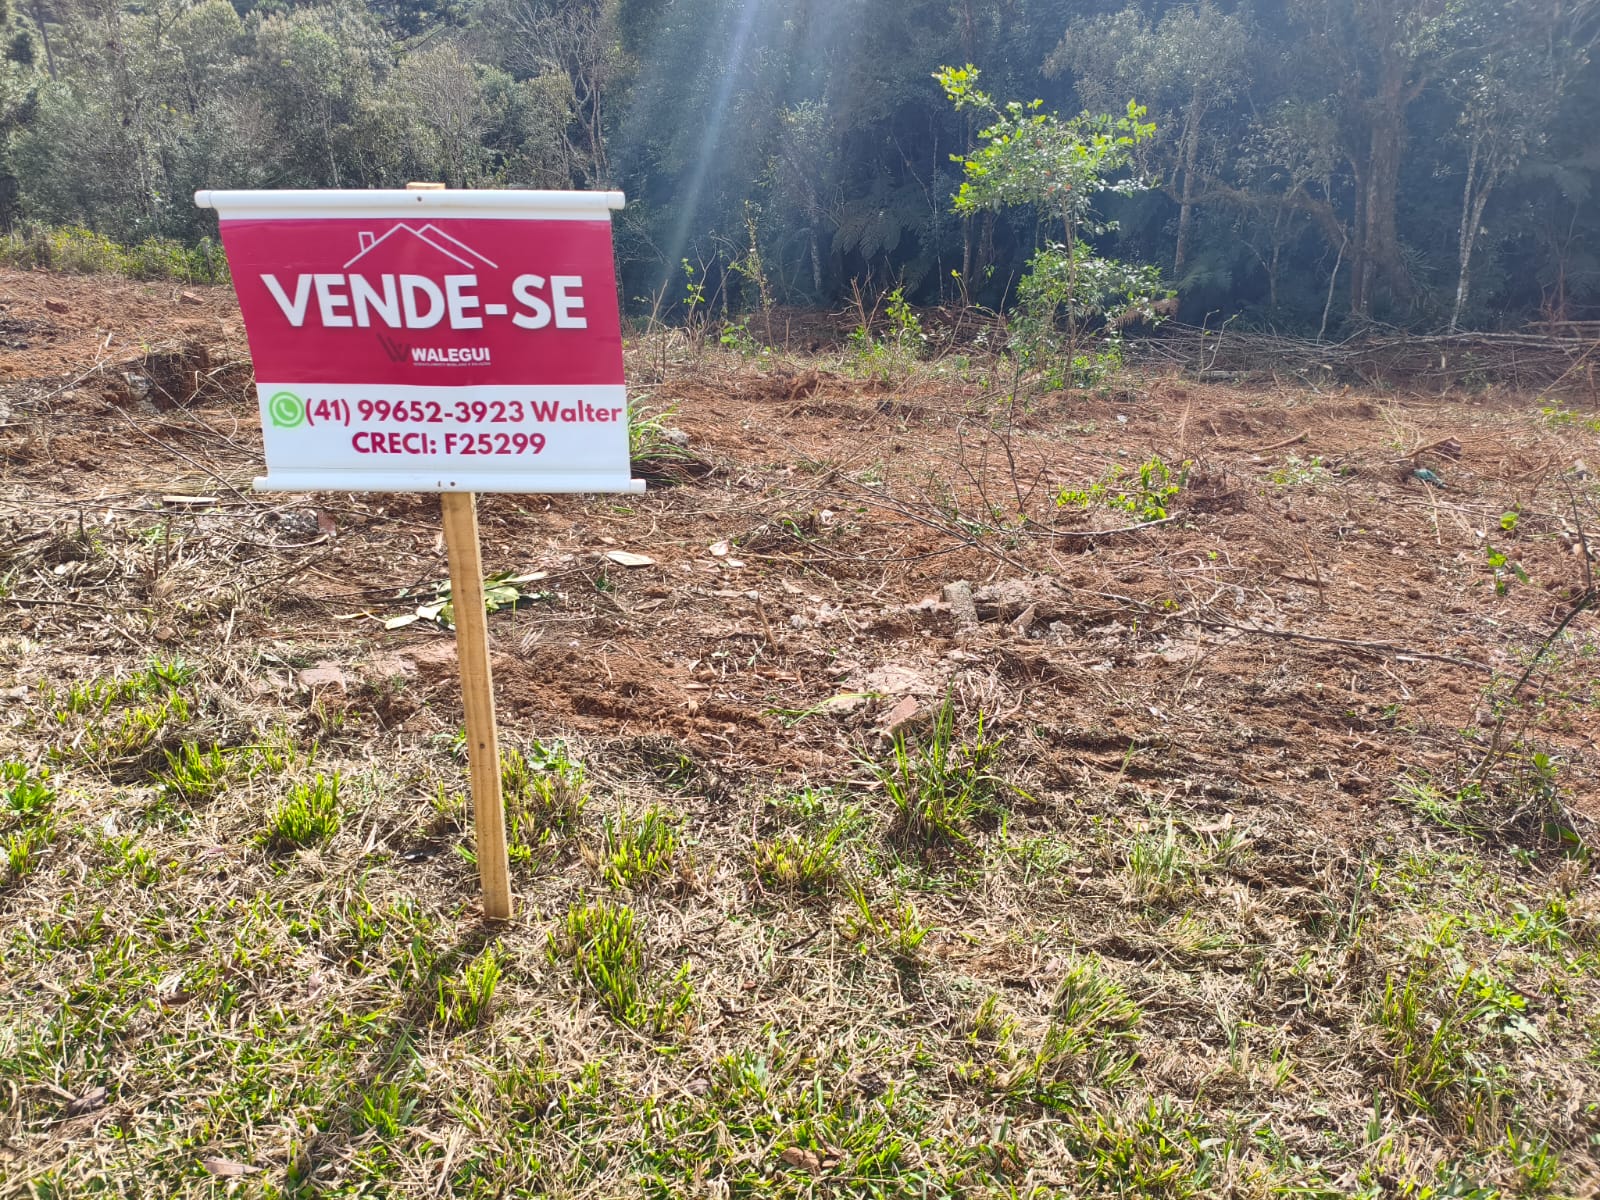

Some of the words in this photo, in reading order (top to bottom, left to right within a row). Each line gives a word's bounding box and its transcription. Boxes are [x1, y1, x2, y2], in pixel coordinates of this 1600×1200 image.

[260, 273, 588, 330] VENDE-SE
[411, 347, 491, 363] WALEGUI
[305, 398, 351, 427] (41)
[362, 399, 524, 424] 99652-3923
[530, 399, 622, 423] Walter
[351, 431, 437, 455] CRECI:
[445, 432, 547, 456] F25299
